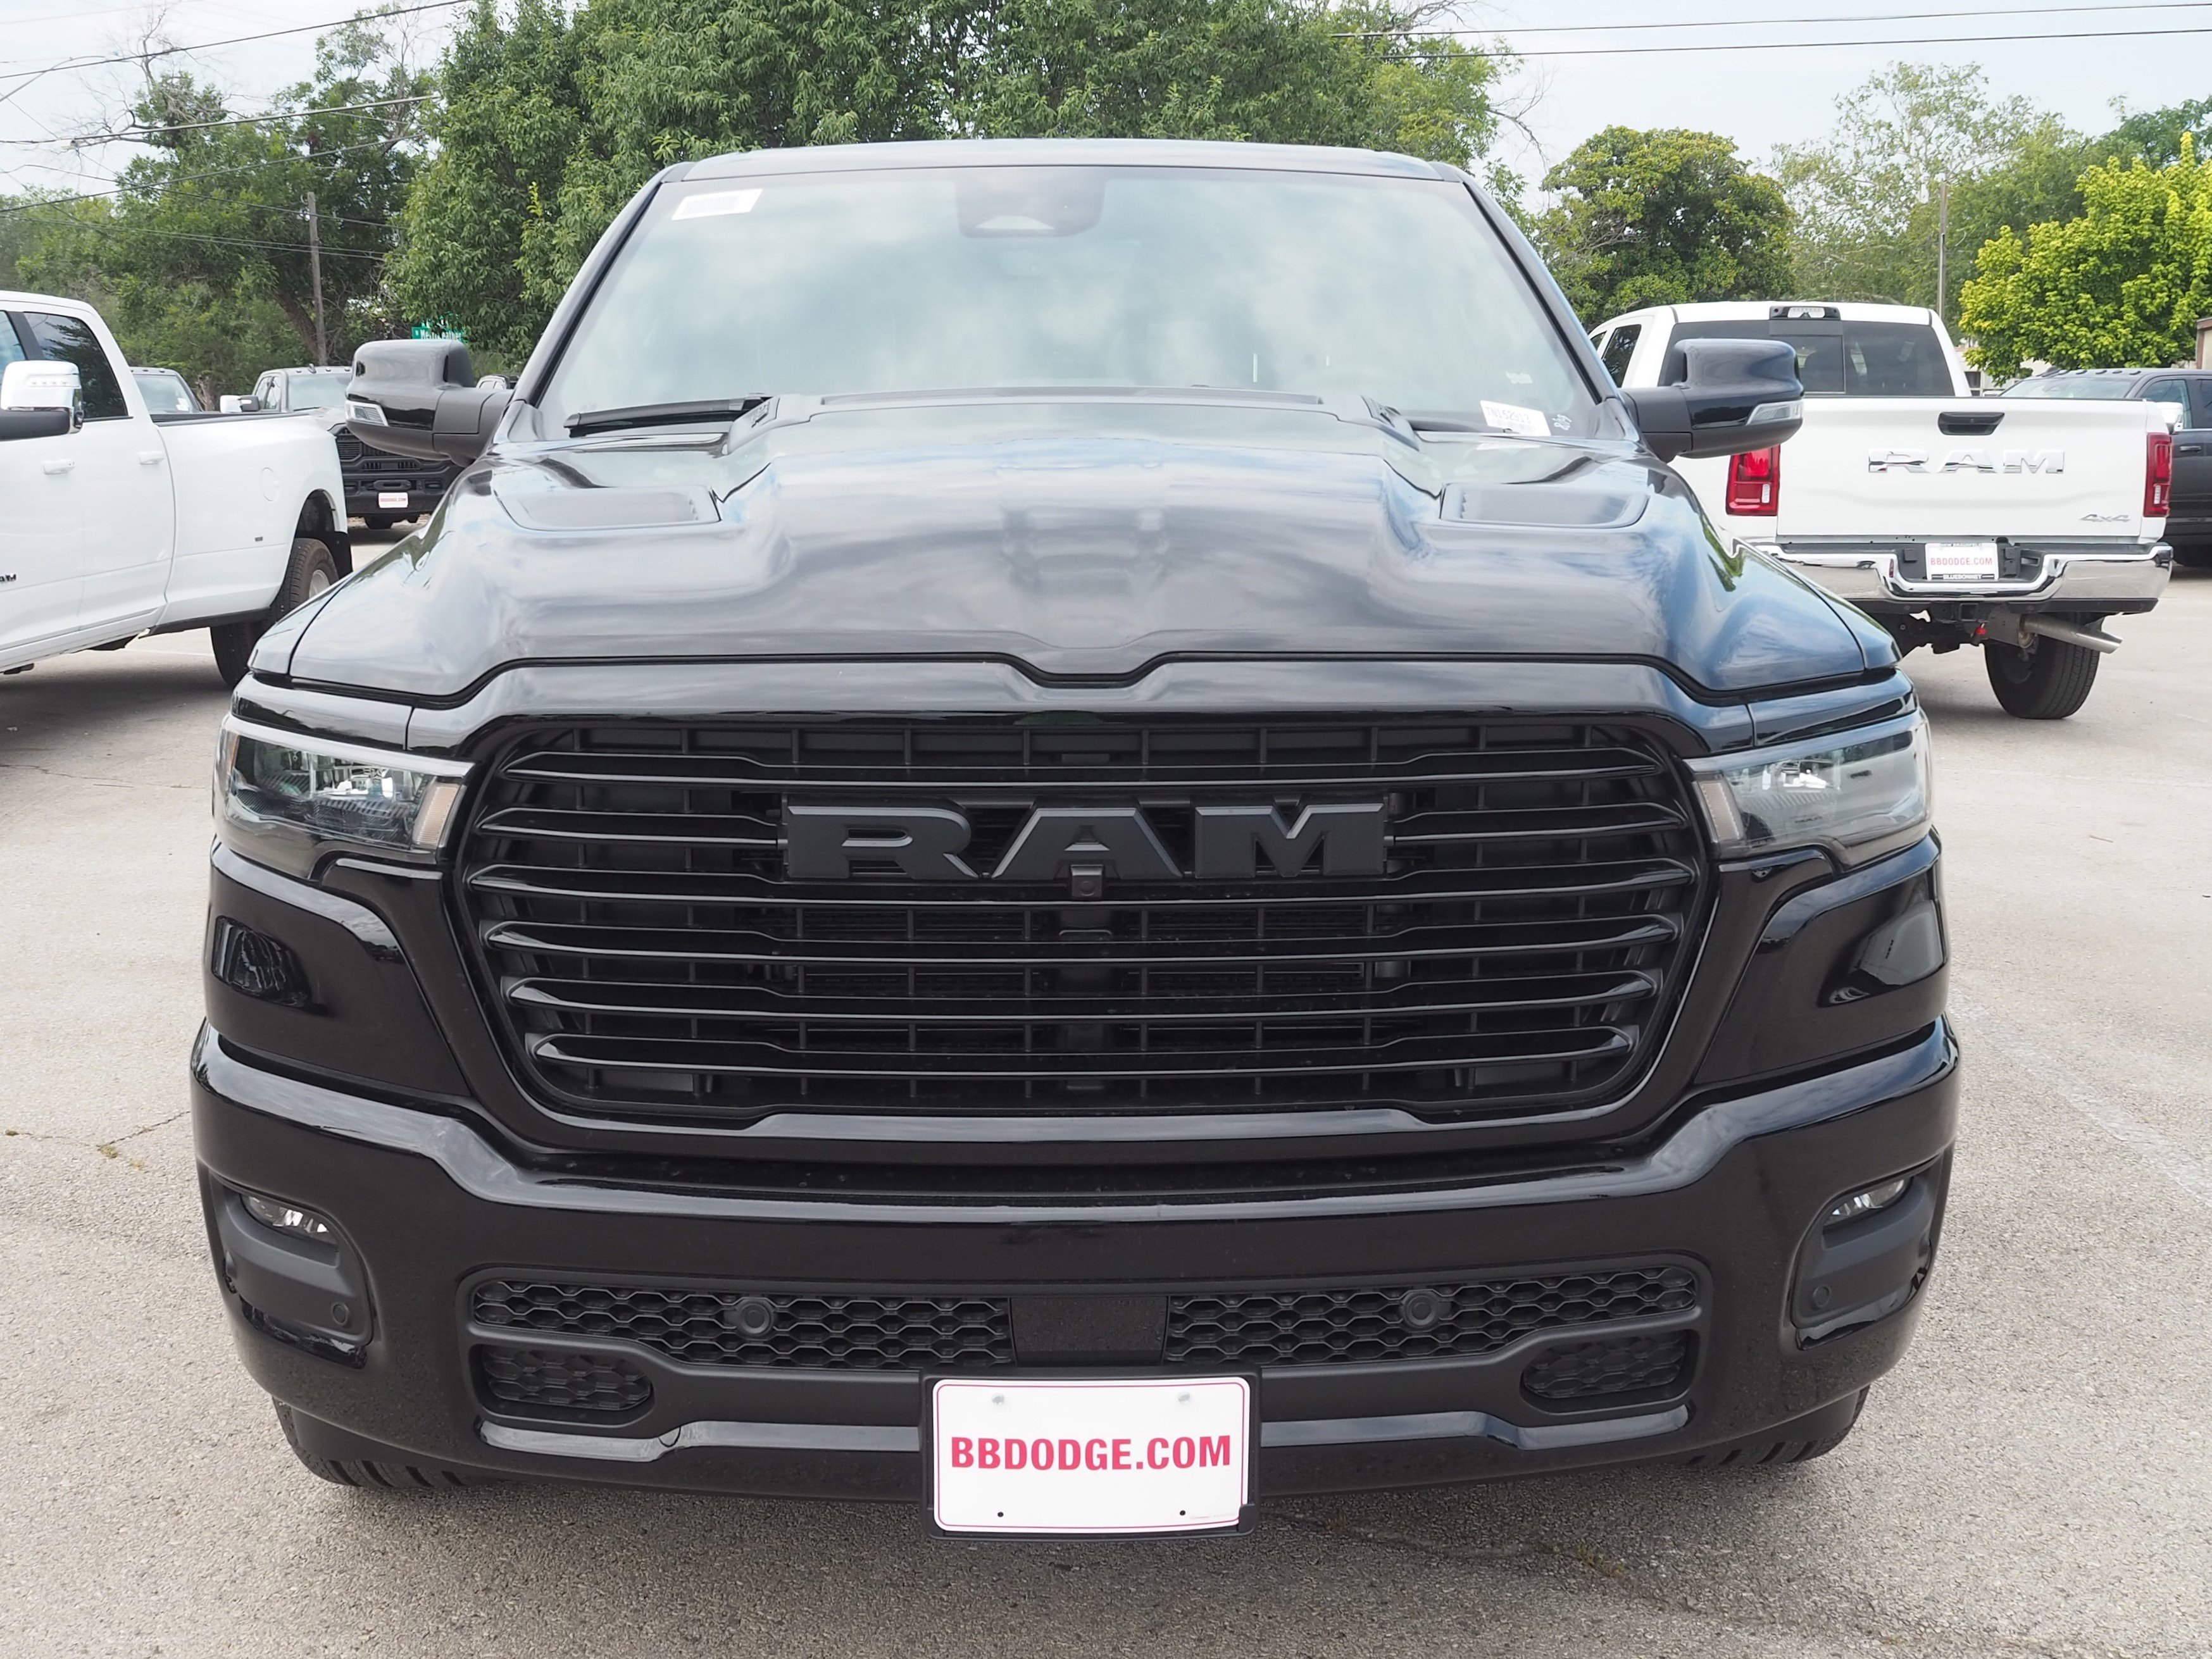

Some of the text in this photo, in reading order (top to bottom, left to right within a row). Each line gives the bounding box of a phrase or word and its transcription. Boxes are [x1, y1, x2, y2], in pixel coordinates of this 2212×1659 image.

[1868, 448, 2065, 474] RAM
[2080, 514, 2131, 523] 4x4
[1930, 557, 1992, 566] BBDODGE.COM
[787, 805, 1385, 879] RAM
[951, 1435, 1231, 1471] BBDODGE.COM
